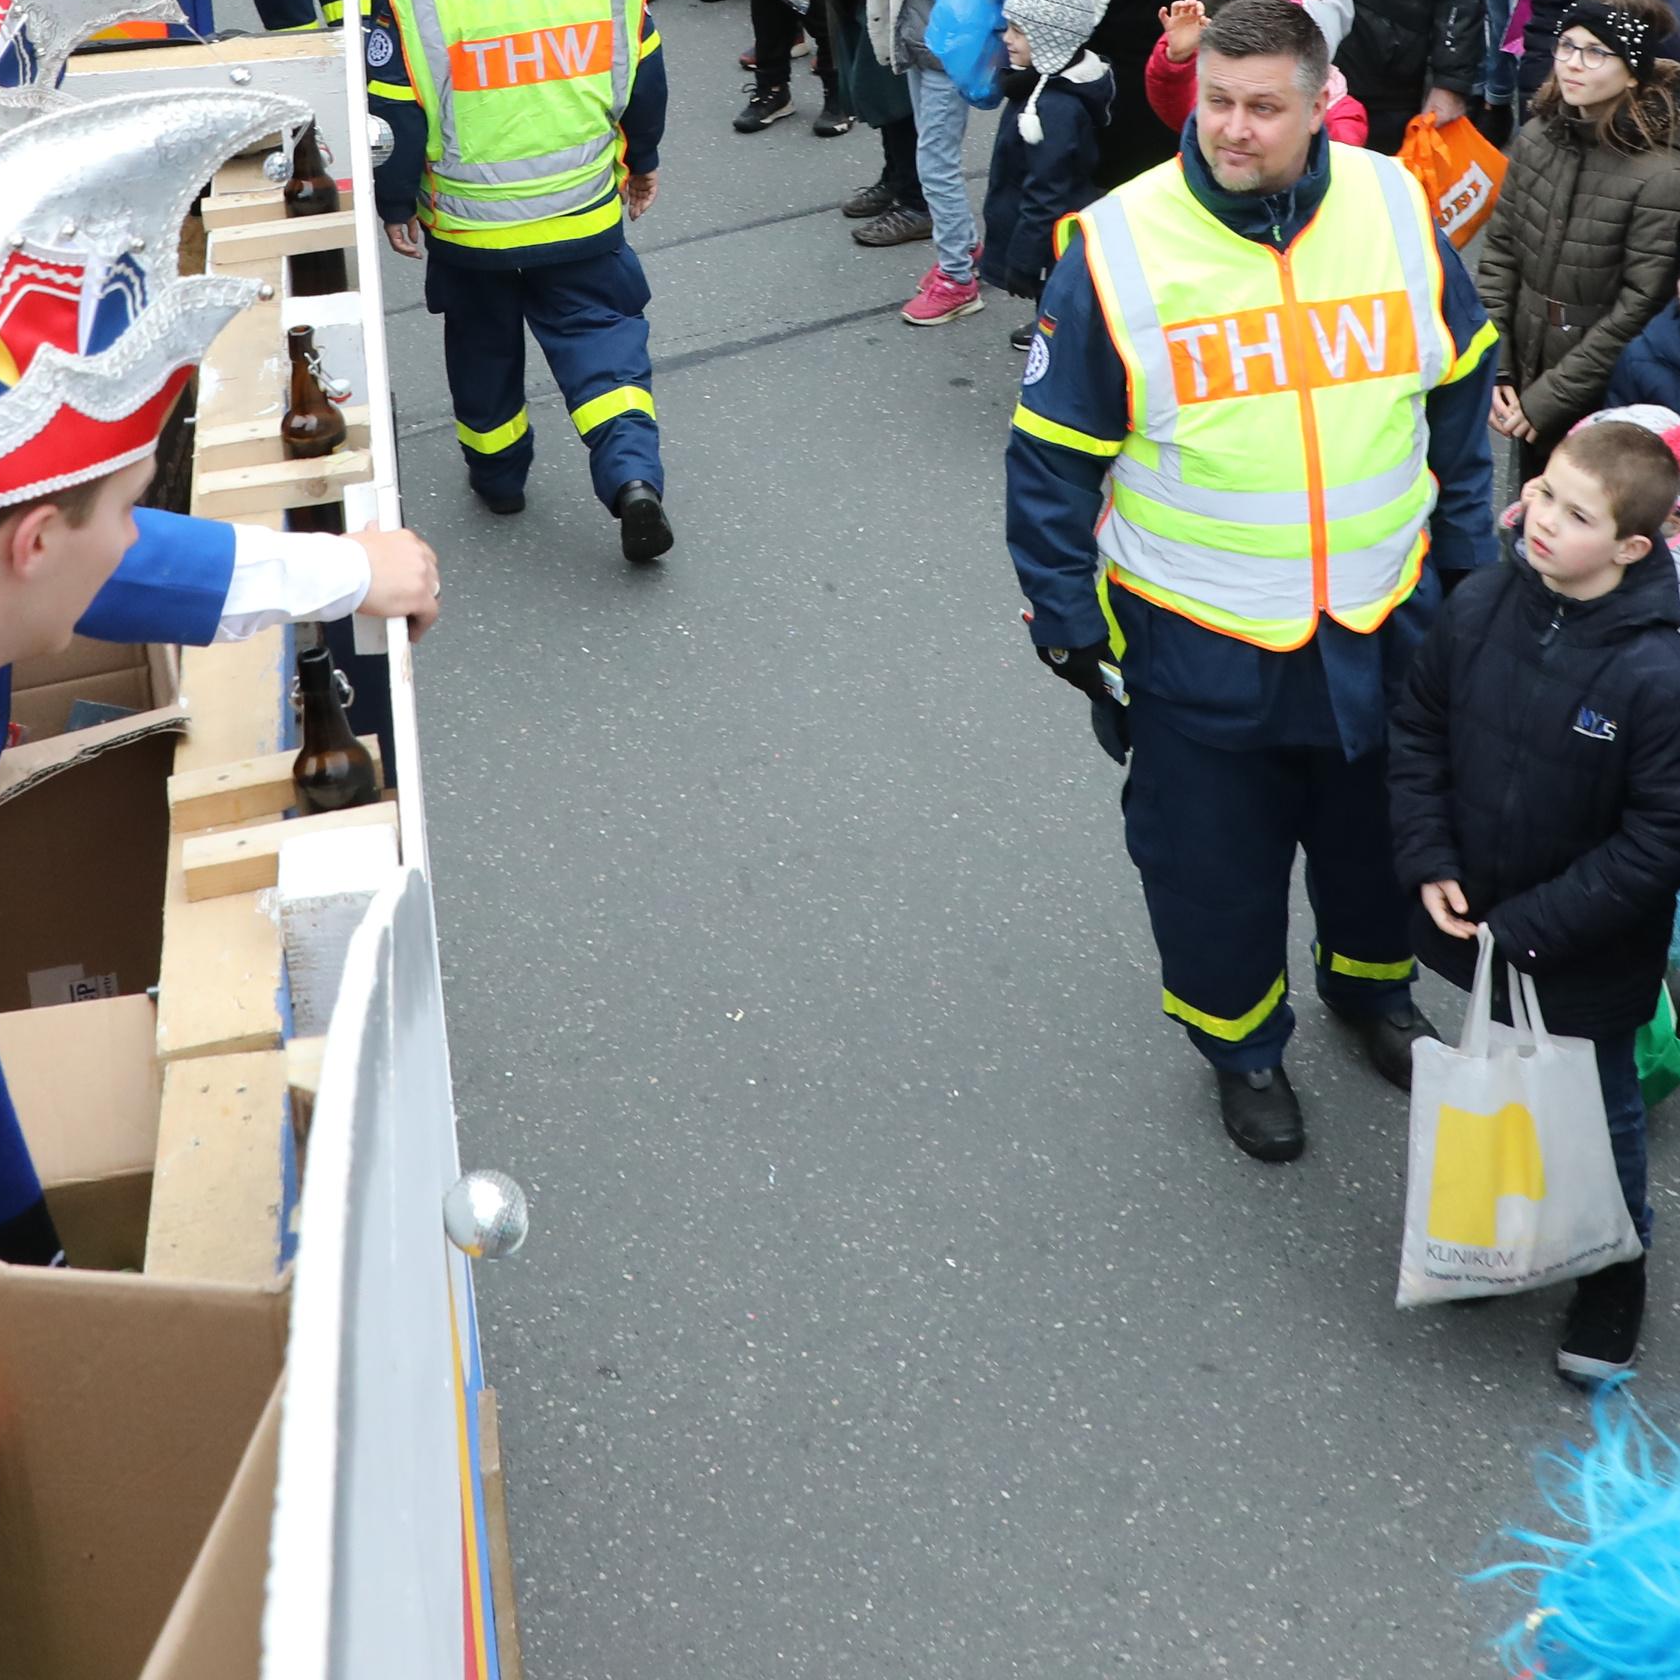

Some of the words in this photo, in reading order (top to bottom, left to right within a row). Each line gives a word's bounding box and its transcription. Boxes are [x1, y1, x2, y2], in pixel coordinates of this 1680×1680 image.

[462, 23, 599, 87] THW
[1438, 180, 1483, 228] OBI
[1166, 299, 1388, 398] THW
[1426, 1241, 1516, 1268] KLINIKUM
